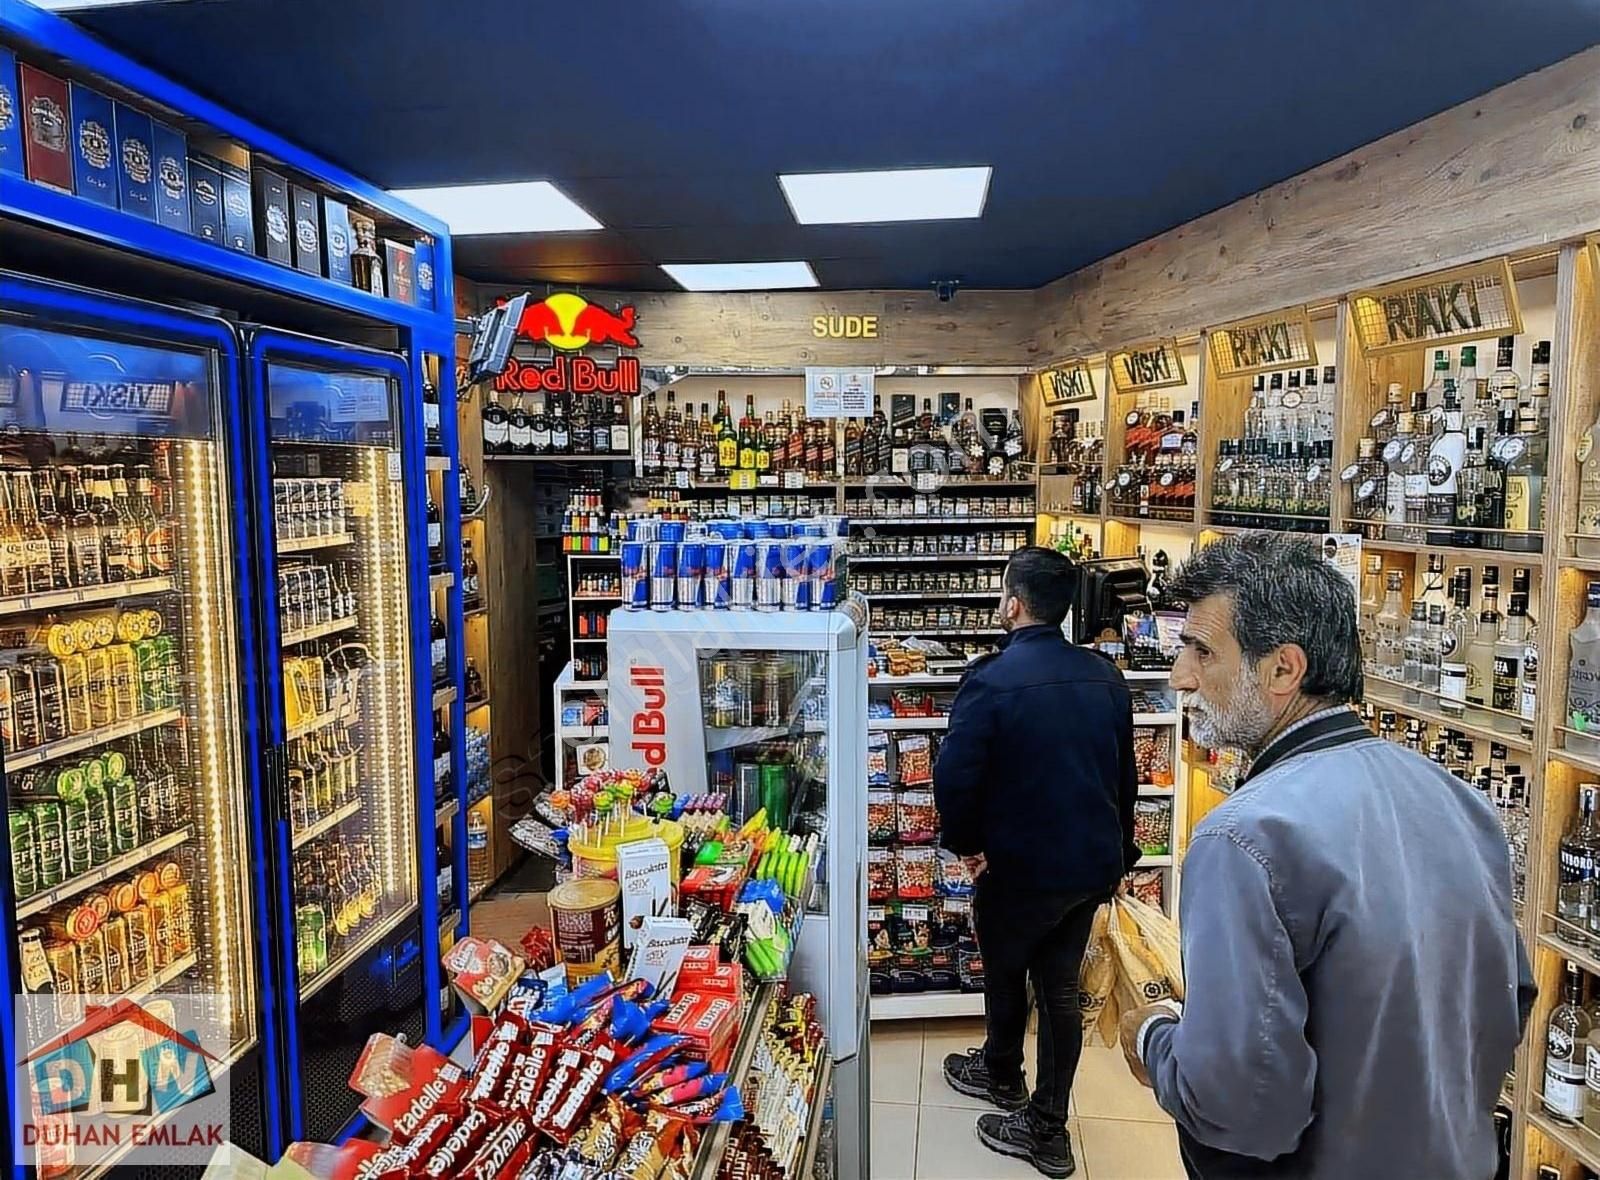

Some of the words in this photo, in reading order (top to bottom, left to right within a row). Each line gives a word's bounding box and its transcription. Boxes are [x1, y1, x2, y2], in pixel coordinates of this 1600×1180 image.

[813, 315, 878, 338] SUDE
[1383, 281, 1482, 342] RAKI
[496, 356, 566, 391] Red
[572, 358, 638, 393] Bull
[1229, 322, 1292, 368] RAKI
[630, 667, 667, 735] Bull
[393, 1080, 448, 1135] tadelle
[510, 1047, 546, 1110] tadelle
[426, 1107, 486, 1177] tadelle
[474, 1121, 527, 1180] tadelle
